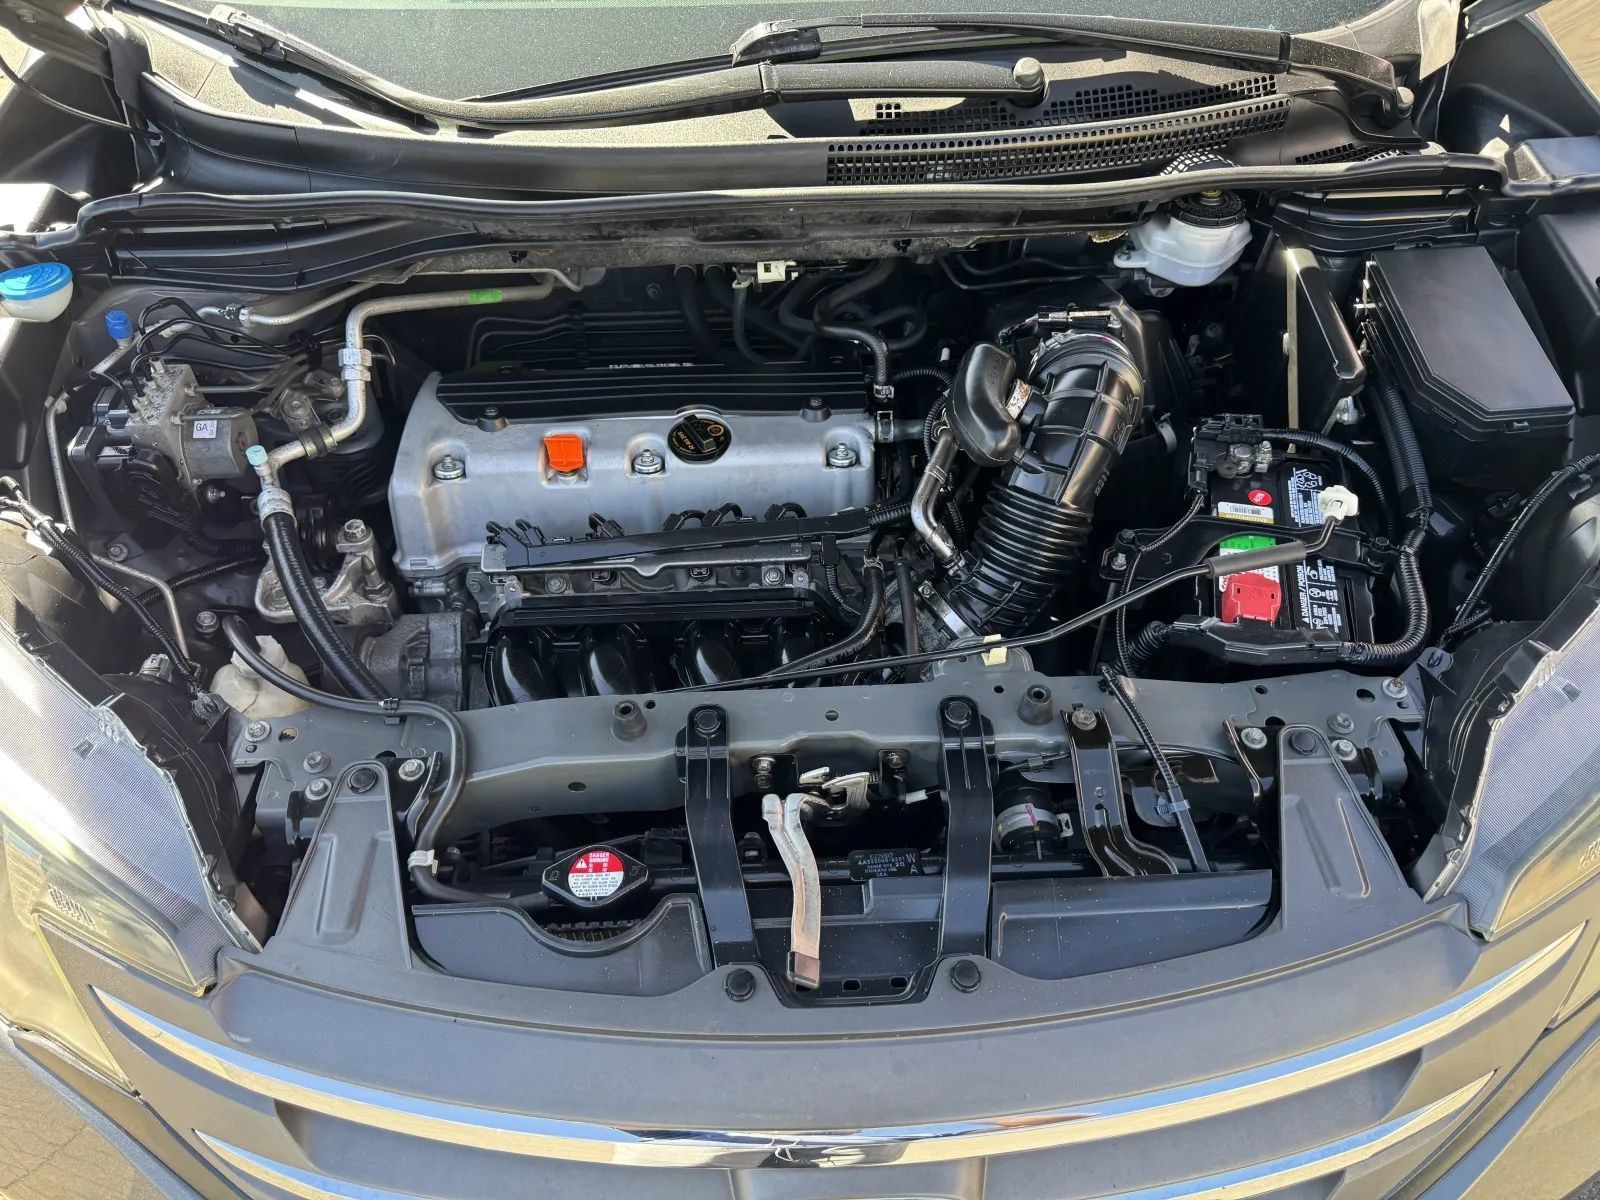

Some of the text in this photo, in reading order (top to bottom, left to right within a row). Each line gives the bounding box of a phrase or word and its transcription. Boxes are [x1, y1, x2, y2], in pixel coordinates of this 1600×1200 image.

[195, 423, 208, 432] GA
[1224, 513, 1268, 523] AUTOMOTIVE
[1296, 564, 1305, 586] POISON
[1300, 591, 1310, 616] DANGER
